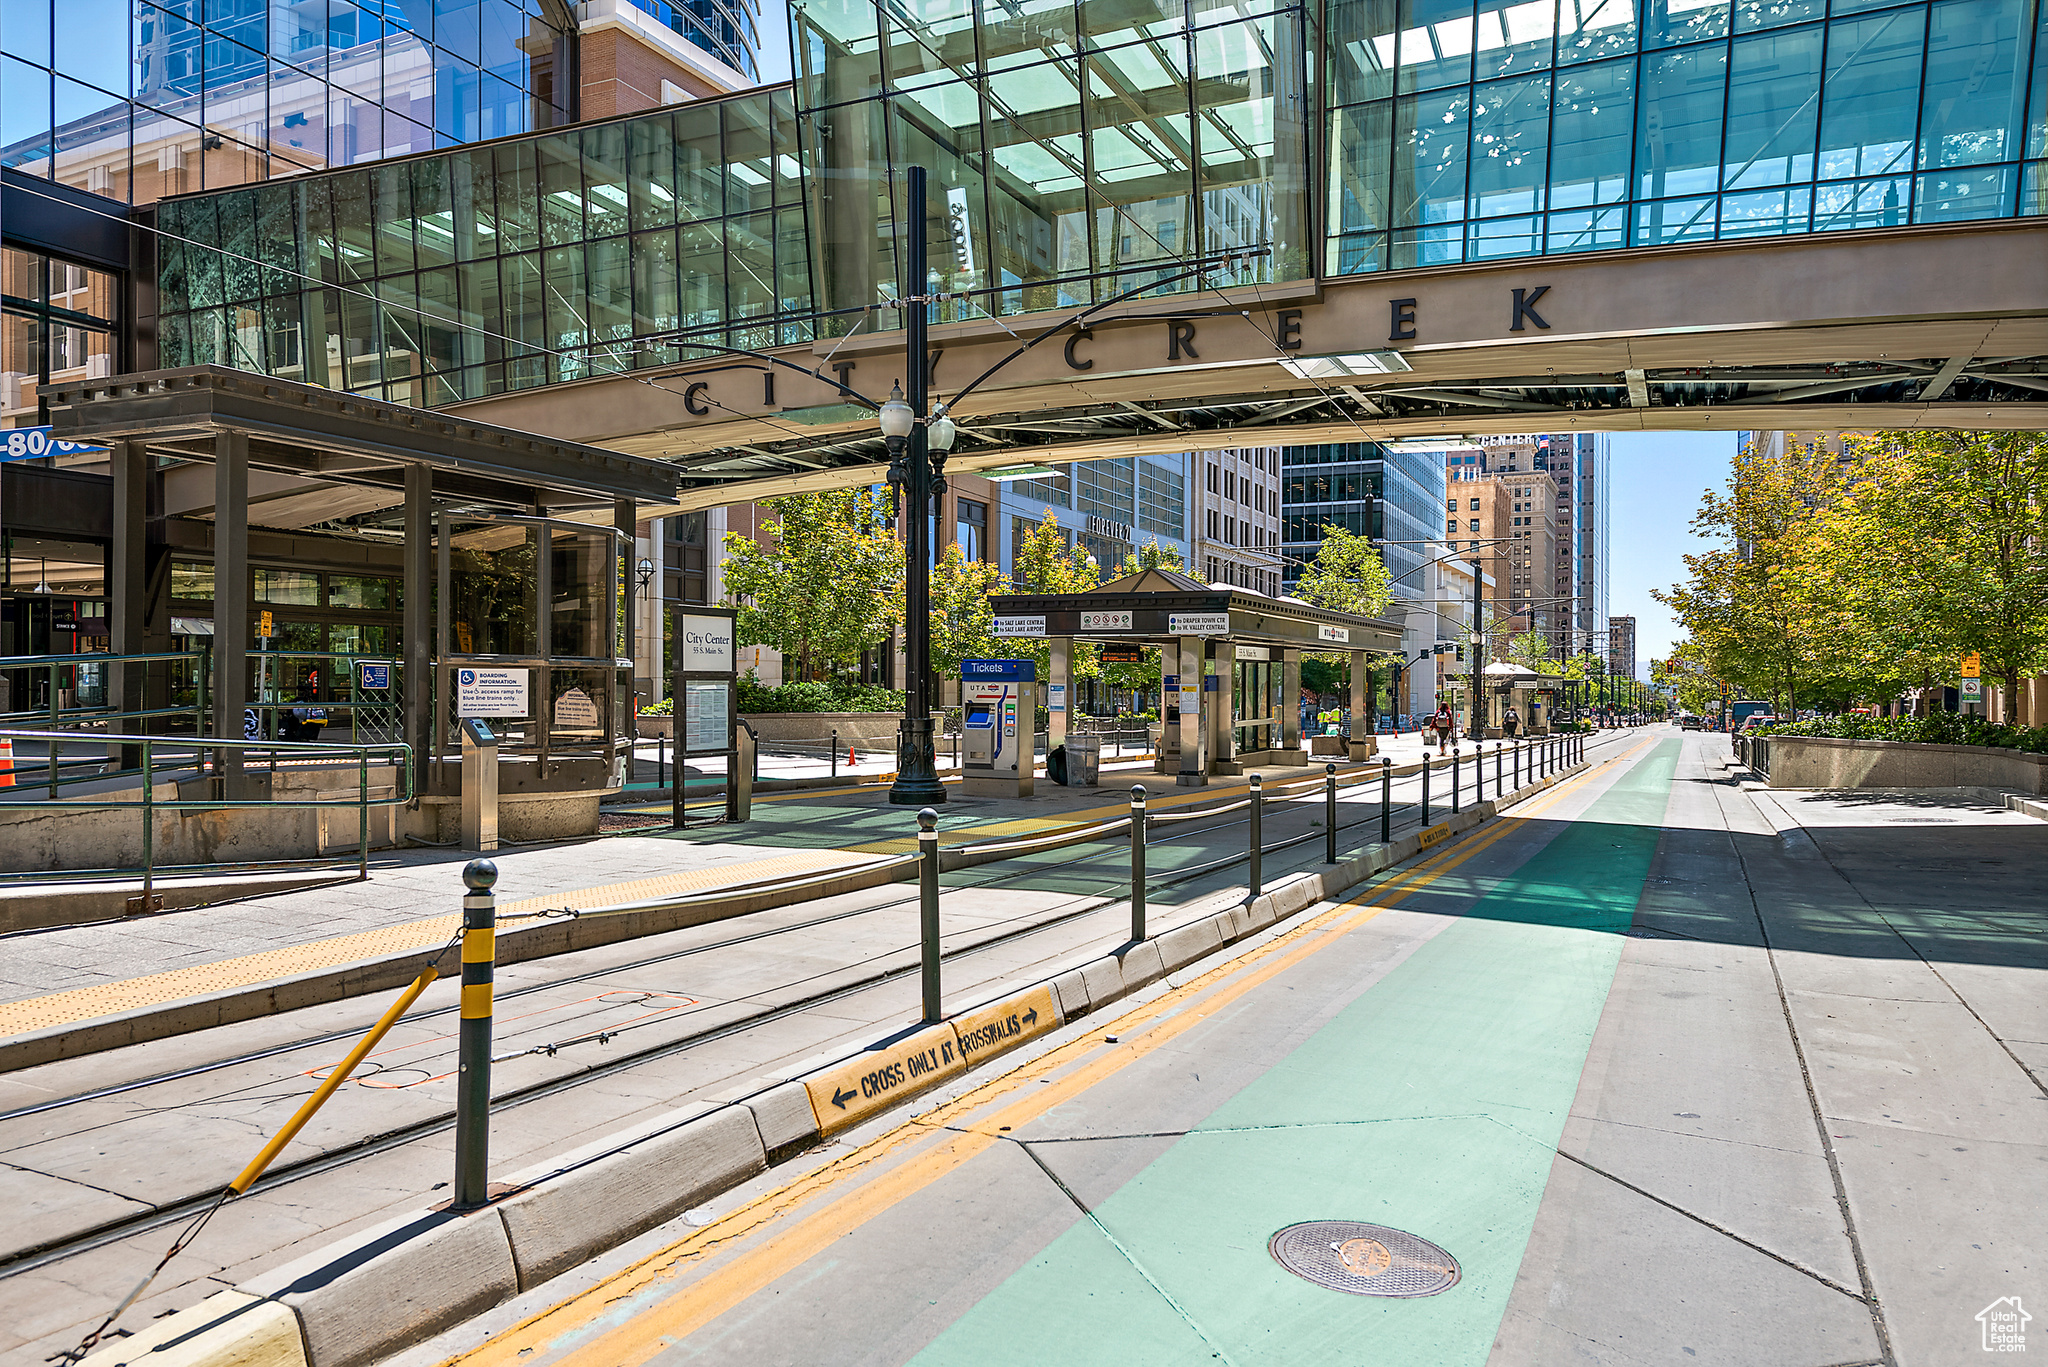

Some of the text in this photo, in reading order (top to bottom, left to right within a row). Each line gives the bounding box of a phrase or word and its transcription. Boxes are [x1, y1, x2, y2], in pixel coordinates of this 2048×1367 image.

[1064, 285, 1551, 369] CREEK
[1092, 515, 1123, 541] FOREVER
[686, 631, 729, 646] City Center
[971, 662, 1003, 672] Tickets
[861, 1013, 1021, 1098] CROSS ONLY AT CROSSWALKS
